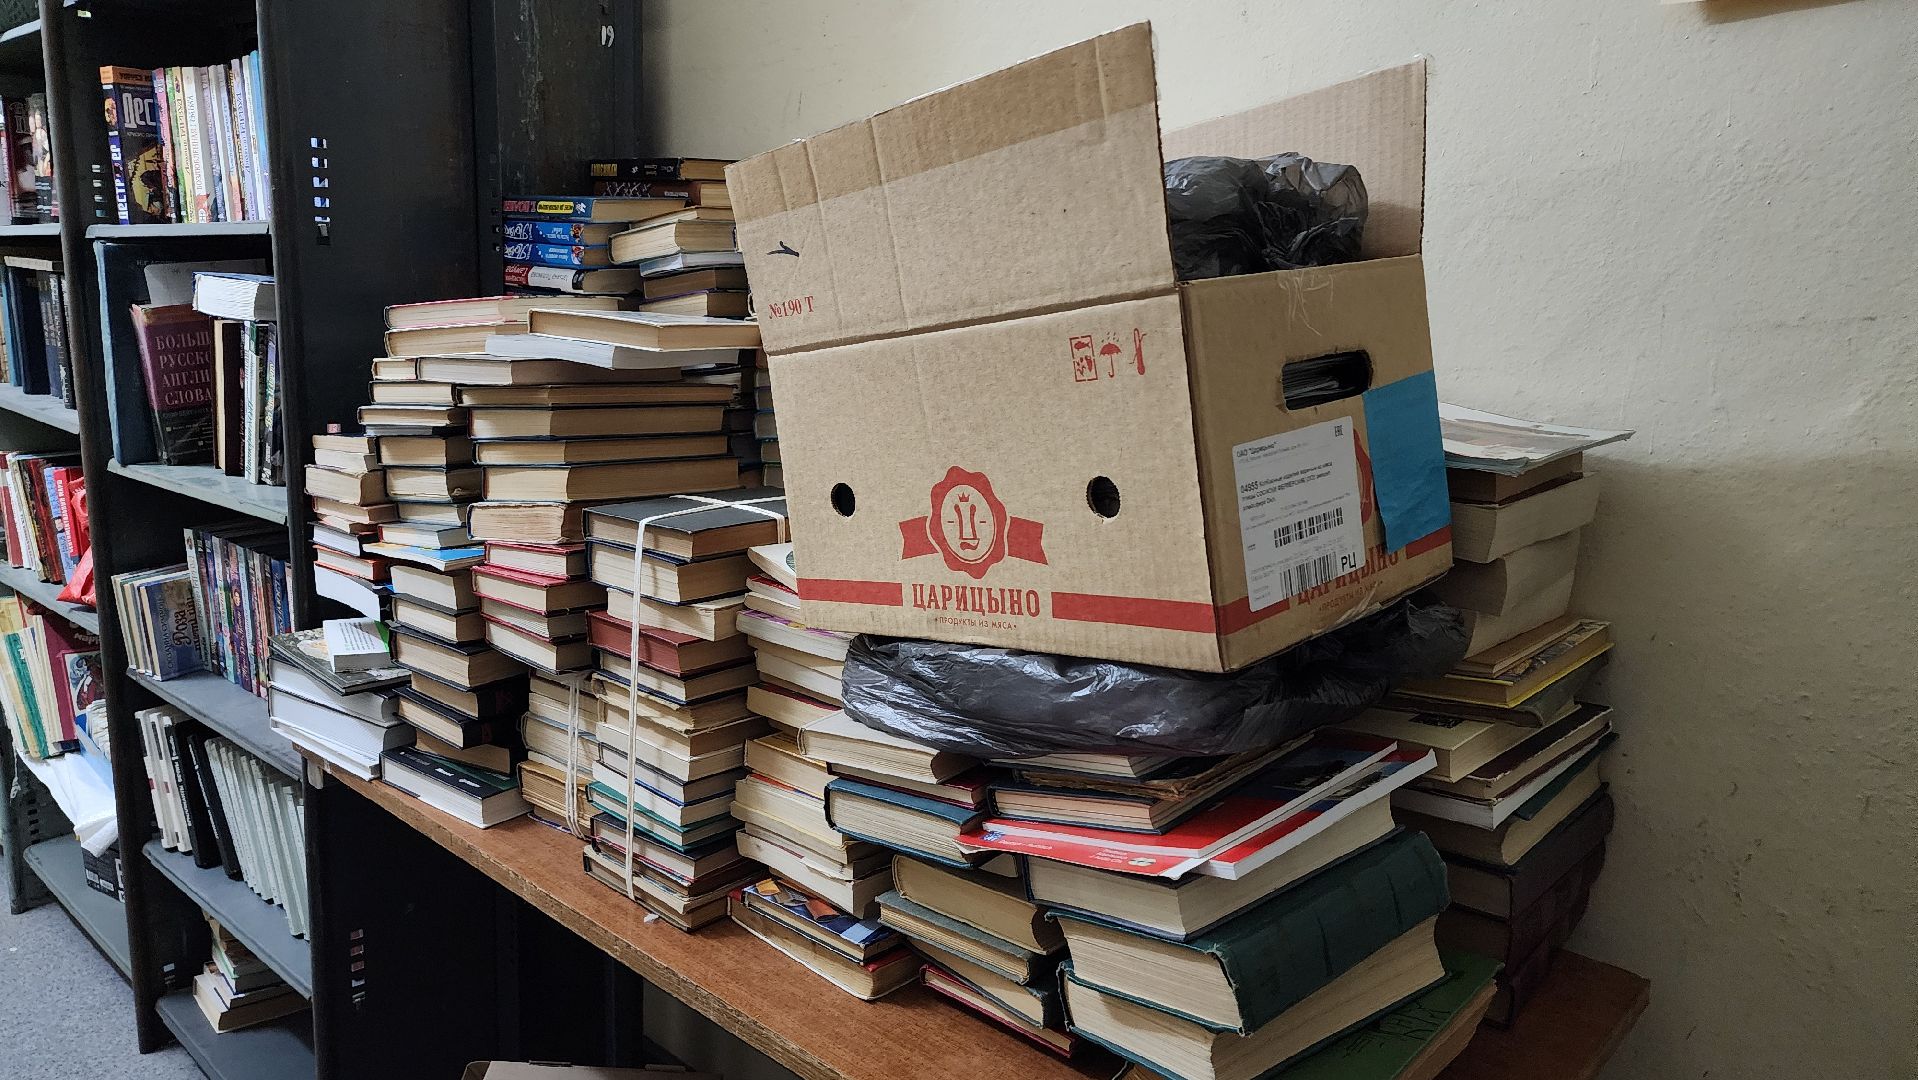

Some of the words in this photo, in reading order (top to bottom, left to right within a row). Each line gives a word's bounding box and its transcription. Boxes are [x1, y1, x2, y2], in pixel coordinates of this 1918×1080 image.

[601, 25, 615, 48] 19
[769, 299, 802, 320] №190
[1340, 551, 1357, 573] РЦ
[912, 583, 1041, 618] ЦАРИЦЫНО
[172, 609, 192, 646] Роза
[939, 616, 977, 627] ПРОДУКТЫ
[978, 620, 989, 628] ИЗ
[991, 621, 1013, 631] МЯСА
